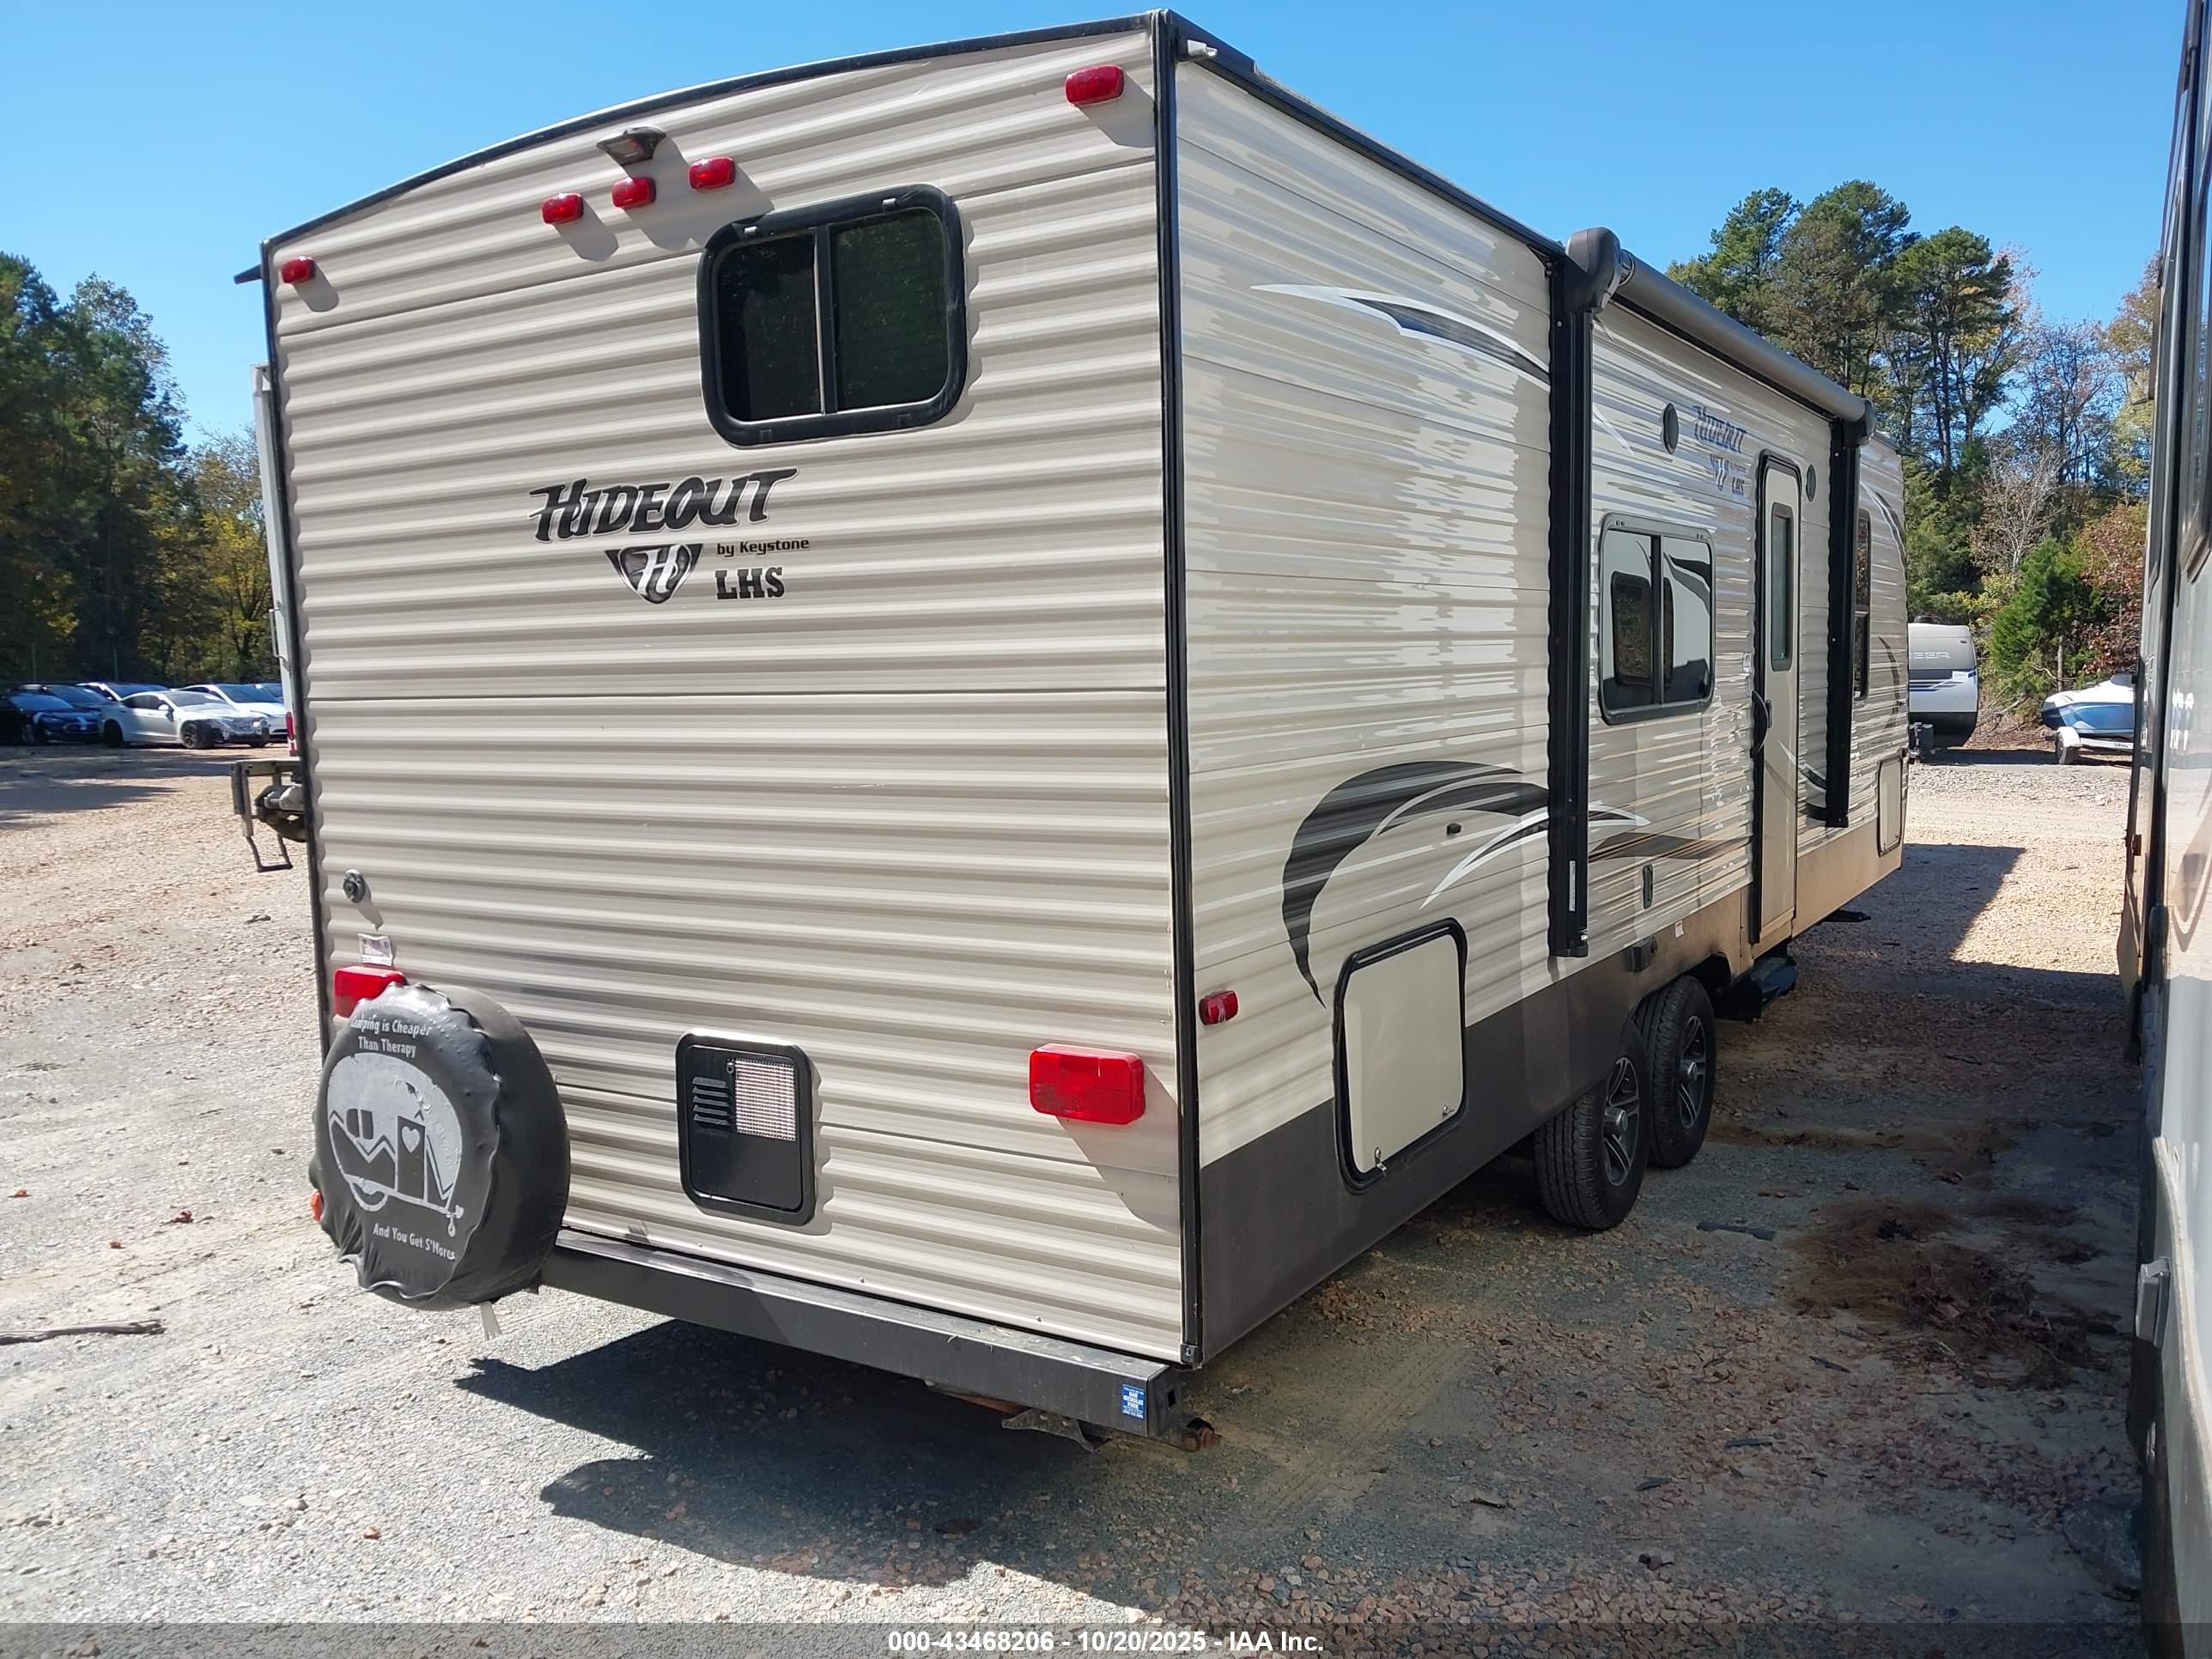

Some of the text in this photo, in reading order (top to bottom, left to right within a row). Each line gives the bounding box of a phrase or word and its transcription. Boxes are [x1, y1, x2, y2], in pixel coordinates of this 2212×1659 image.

[529, 468, 799, 543] HIDEOUT
[716, 539, 810, 558] by Keystone
[714, 567, 785, 599] LHS
[381, 1018, 390, 1032] is
[392, 1018, 432, 1038] Cheaper
[358, 1036, 416, 1058] Than Therapy
[373, 1222, 455, 1260] And You Get S'Mores
